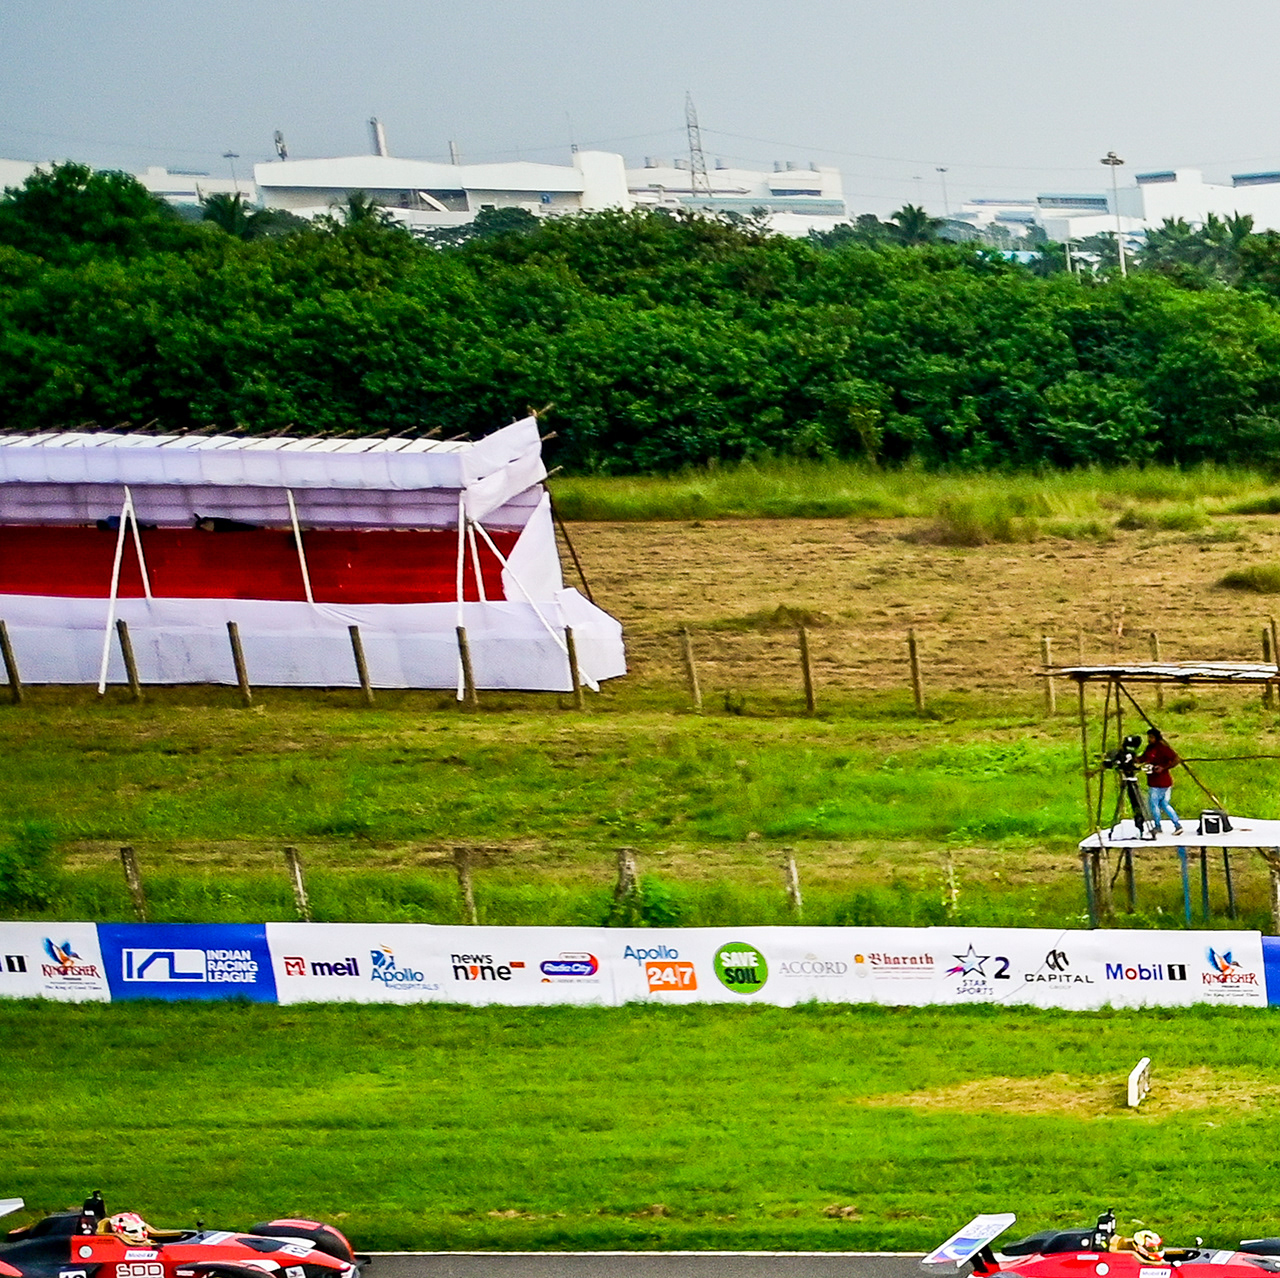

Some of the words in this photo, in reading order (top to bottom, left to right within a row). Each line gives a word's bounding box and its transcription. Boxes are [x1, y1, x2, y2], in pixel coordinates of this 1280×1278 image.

[207, 949, 252, 961] INDIAN
[450, 953, 493, 965] news
[624, 944, 679, 966] Apollo
[720, 951, 759, 967] SAVE
[868, 953, 935, 966] Bharath
[207, 961, 259, 973] RACING
[312, 958, 361, 977] meil
[780, 962, 848, 975] ACCORD
[994, 956, 1011, 979] 2
[1106, 963, 1163, 981] Mobil
[207, 972, 258, 983] LEAGUE
[371, 968, 425, 986] Apollo
[724, 968, 761, 985] SOIL
[1025, 973, 1094, 984] CAPITAL
[1201, 972, 1259, 987] KINGFISHER
